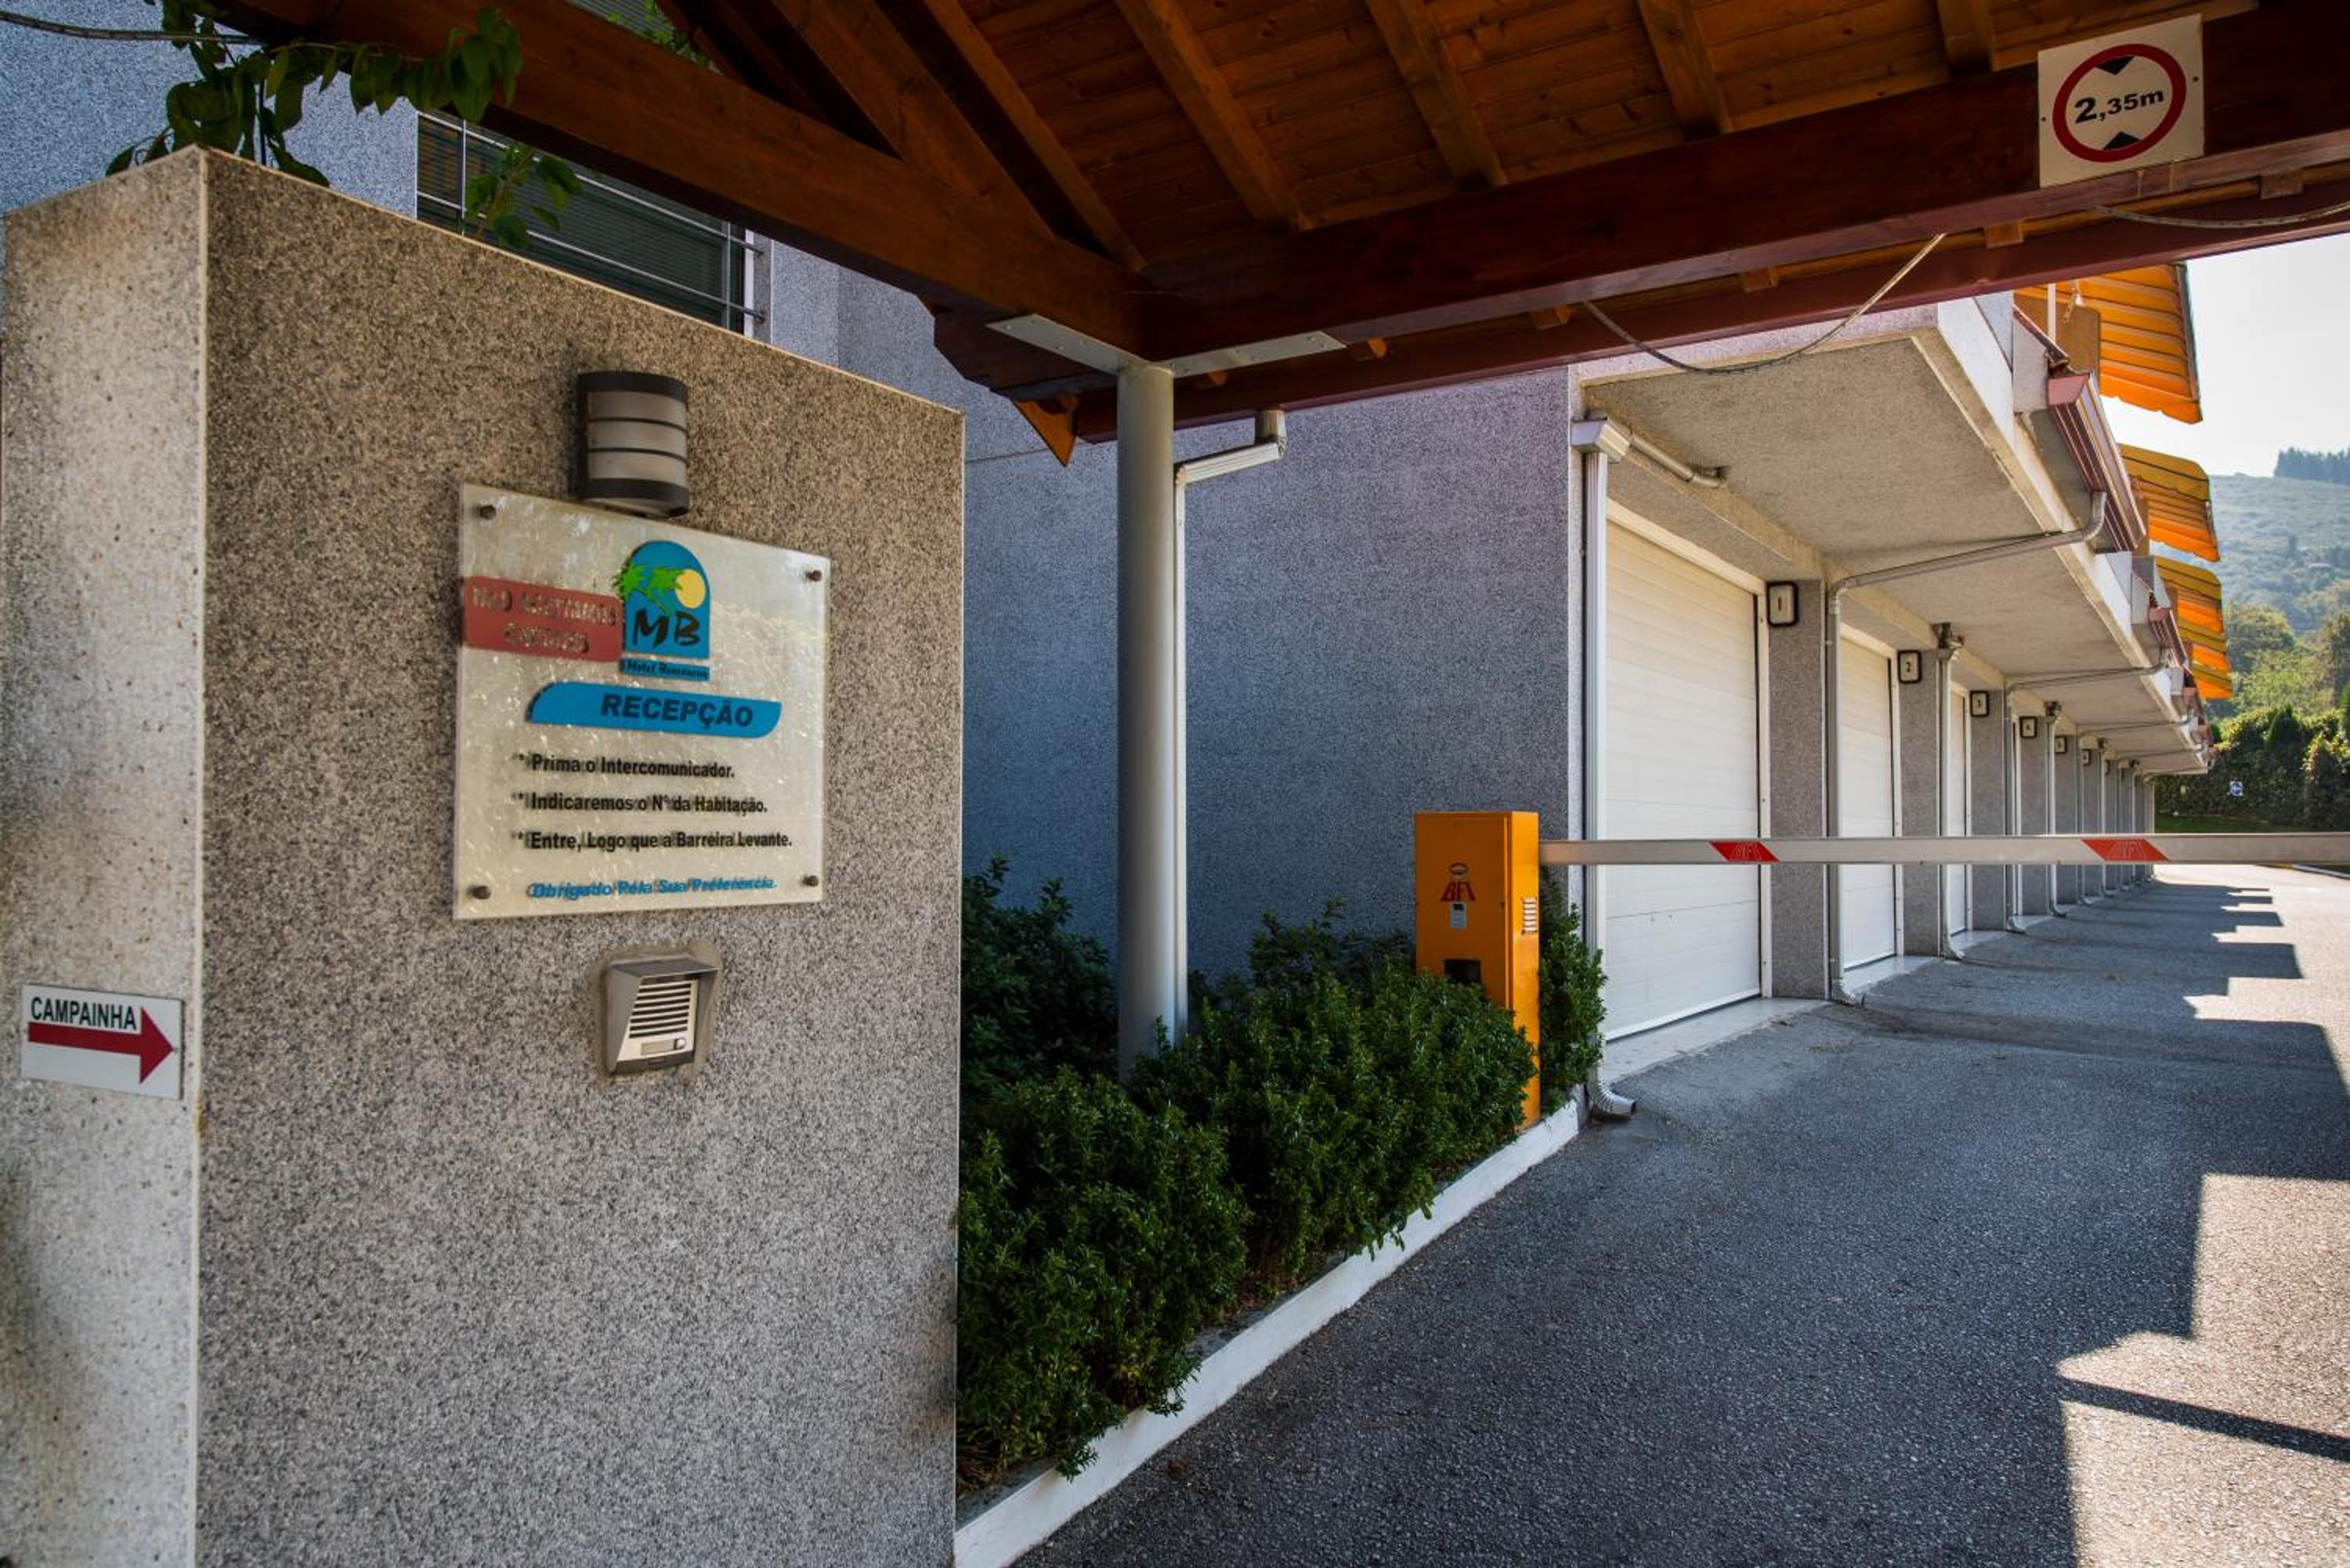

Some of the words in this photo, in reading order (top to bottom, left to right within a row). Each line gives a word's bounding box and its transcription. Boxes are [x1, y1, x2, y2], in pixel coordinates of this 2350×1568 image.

[2074, 89, 2164, 124] 2,35m
[631, 607, 702, 648] MB
[601, 693, 753, 729] RECEPÇÃO
[530, 753, 580, 773] Prima
[585, 759, 596, 773] o
[601, 757, 735, 778] Intercomunicador.
[531, 792, 634, 811] Indicaremos
[638, 798, 648, 811] o
[673, 796, 691, 811] da
[695, 796, 768, 817] Habitação.
[530, 831, 582, 852] Entre,
[588, 832, 626, 852] Logo
[631, 835, 659, 852] que
[663, 835, 672, 847] a
[677, 831, 734, 847] Barreira
[738, 831, 792, 847] Levante.
[530, 880, 613, 901] Obrigado
[31, 996, 137, 1031] CAMPAINHA
